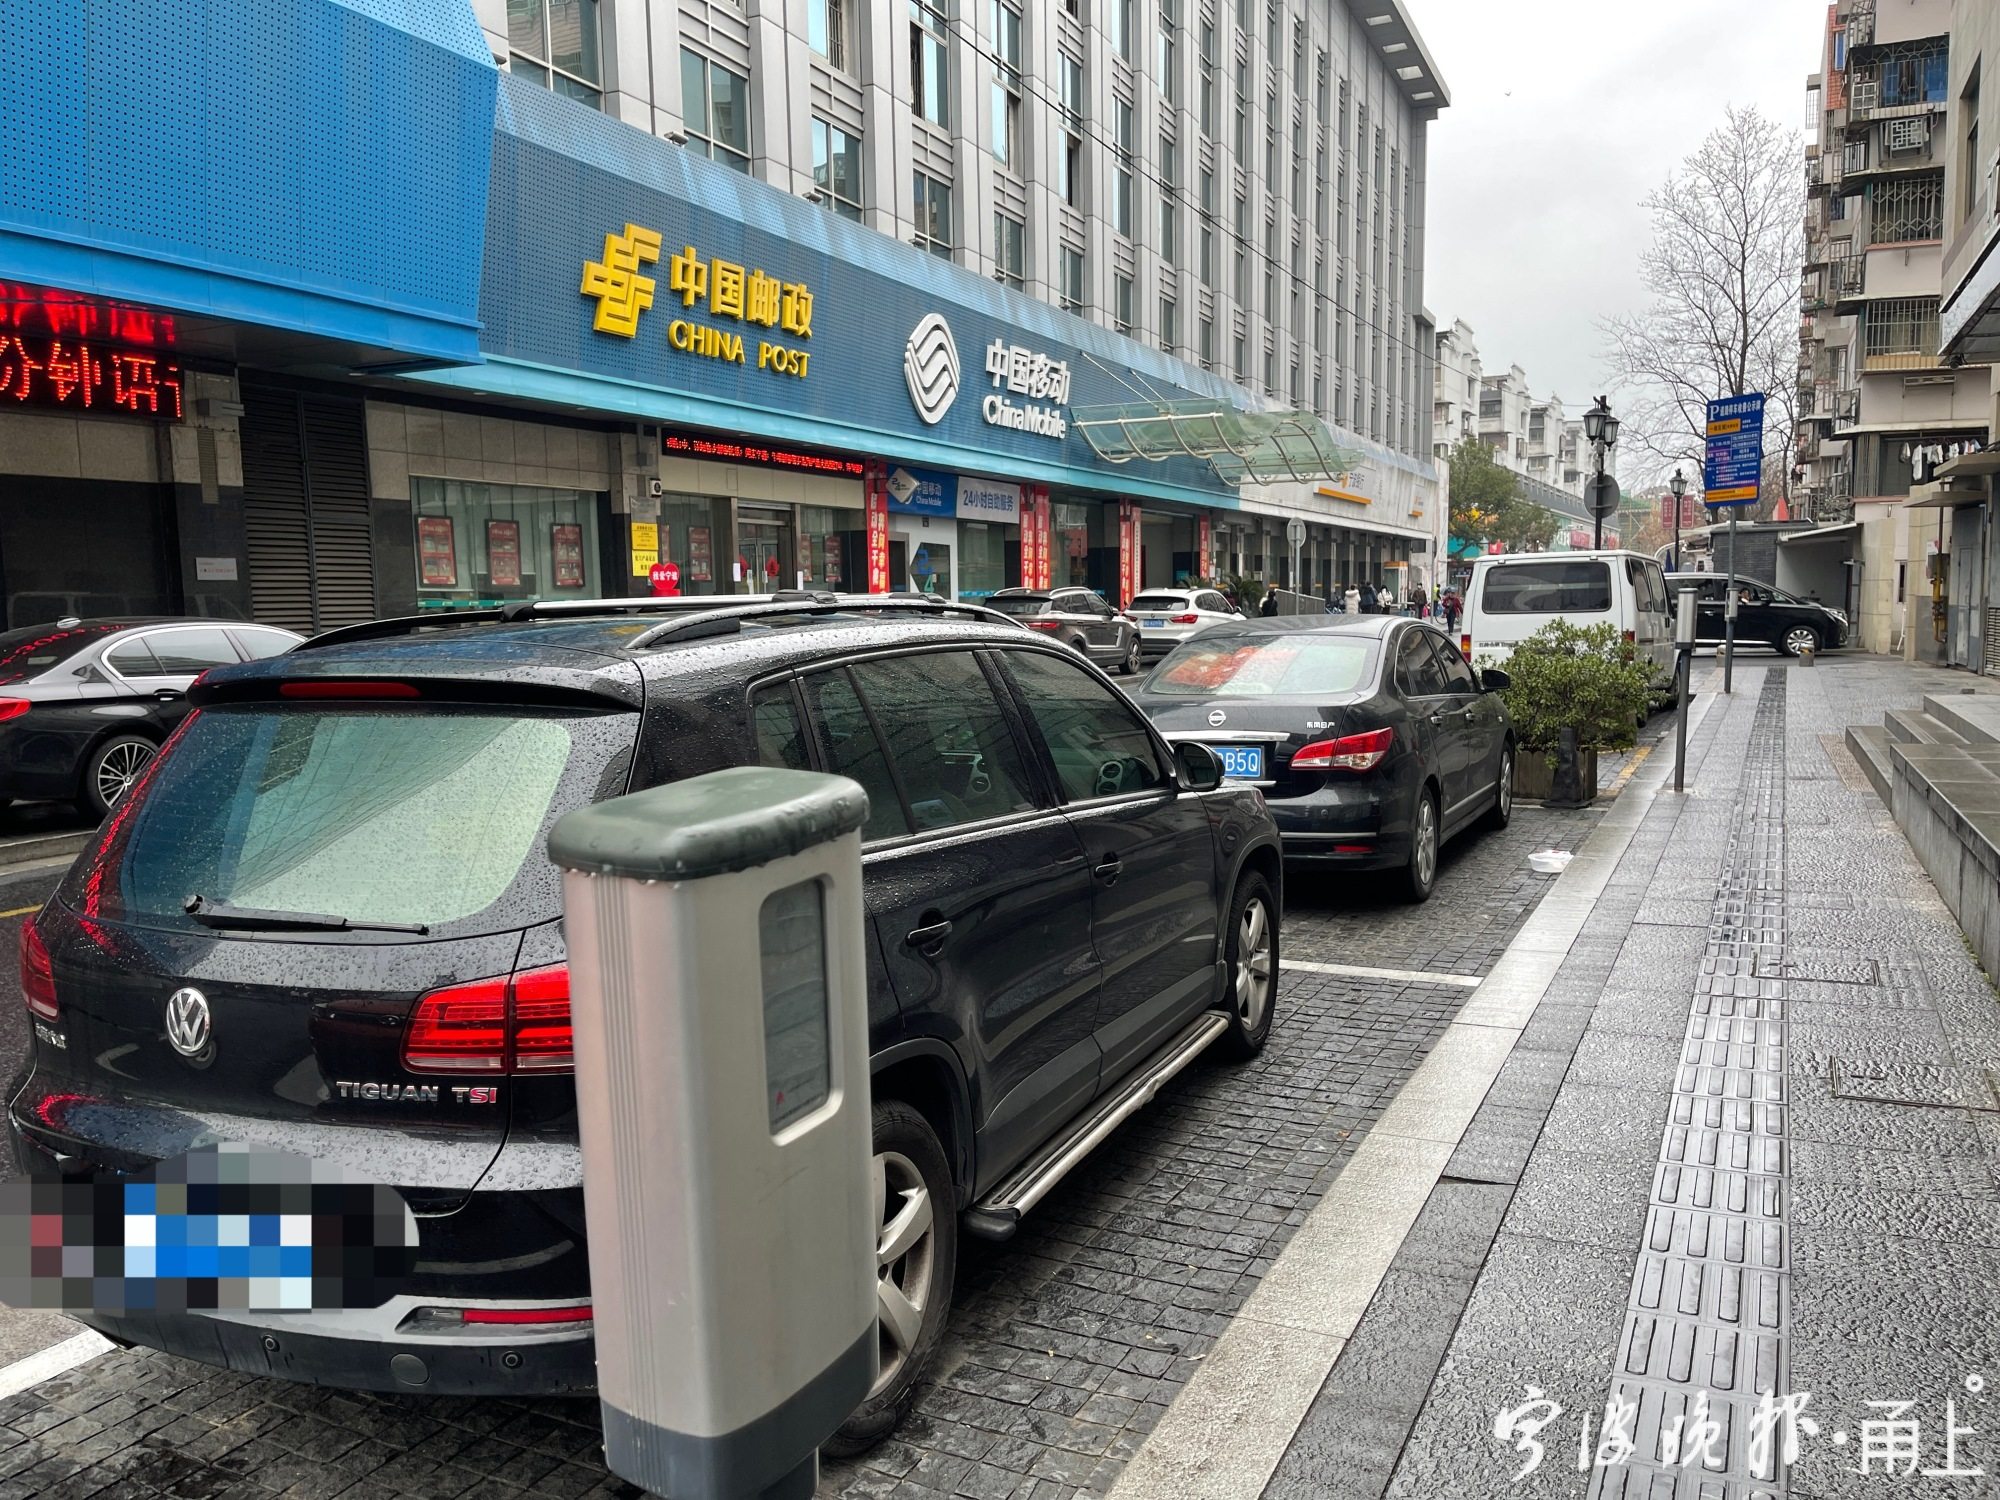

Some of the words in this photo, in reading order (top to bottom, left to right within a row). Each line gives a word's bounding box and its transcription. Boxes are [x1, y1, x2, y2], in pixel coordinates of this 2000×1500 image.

[671, 245, 814, 340] 中国邮政
[668, 319, 746, 365] CHINA
[759, 341, 811, 378] POST
[985, 338, 1071, 405] 中国移动
[983, 395, 1024, 431] China
[1025, 404, 1067, 439] Mobile
[1709, 404, 1720, 421] P
[963, 490, 1014, 512] 24小时自助服务
[1306, 721, 1335, 729] 东风日产
[1217, 752, 1258, 772] B5Q
[336, 1080, 439, 1102] TIGUAN
[452, 1086, 497, 1104] TSI
